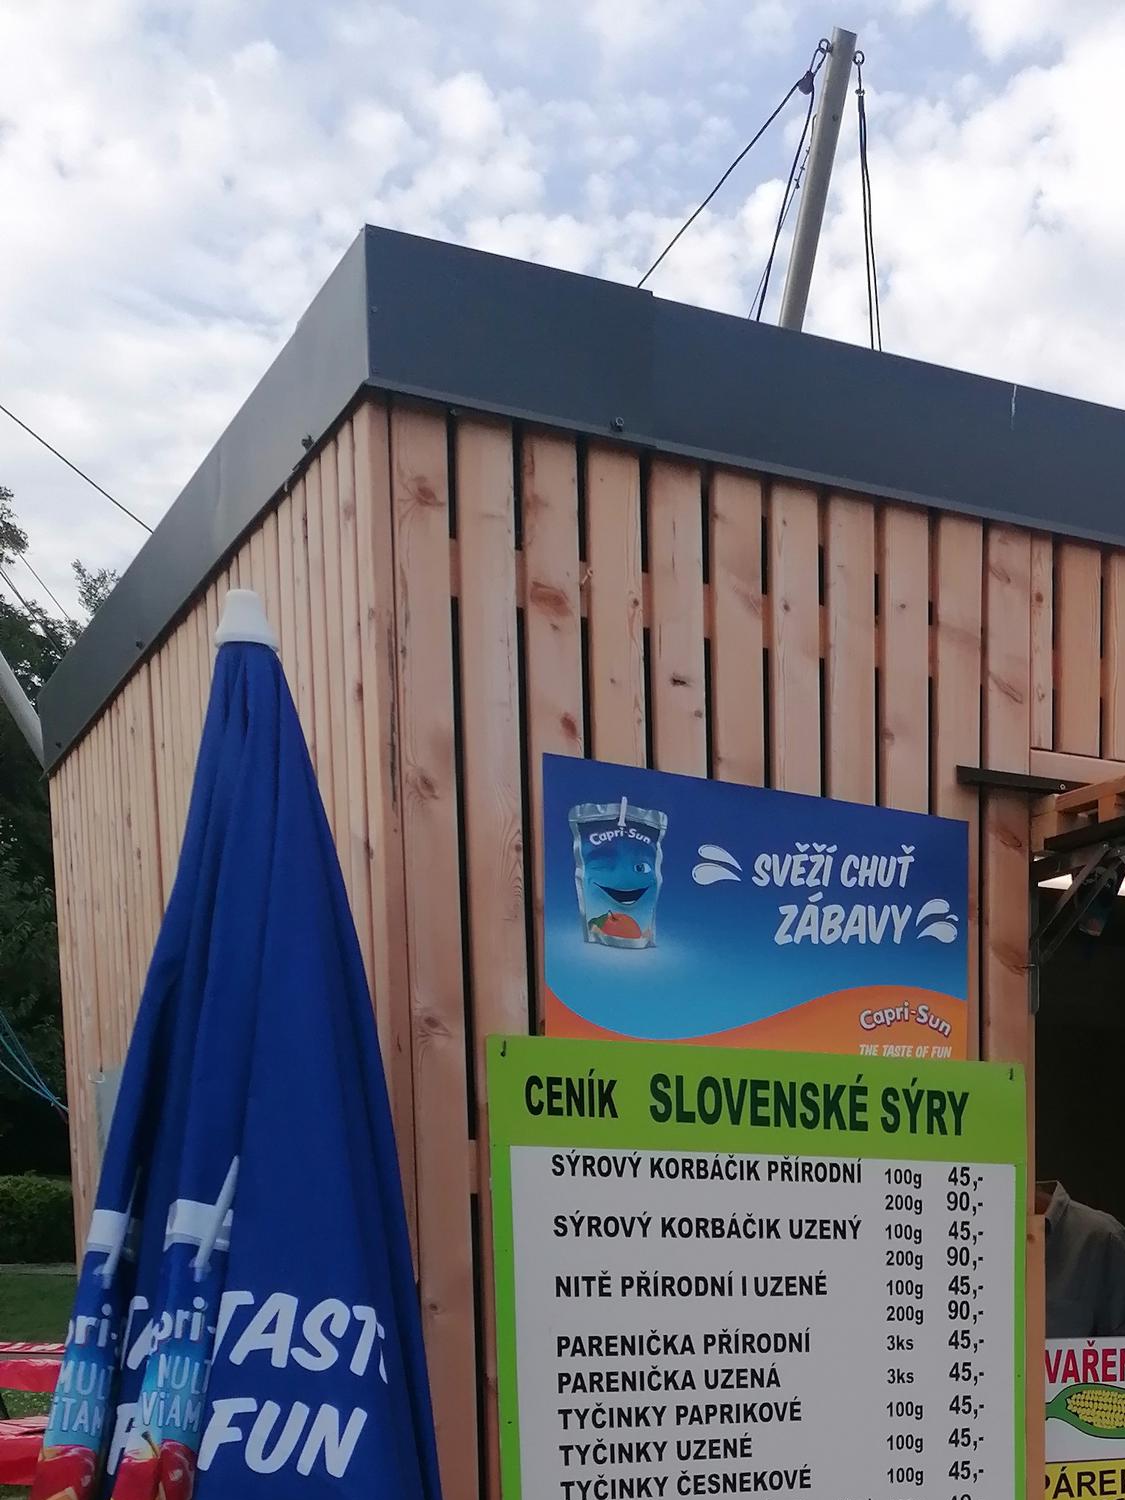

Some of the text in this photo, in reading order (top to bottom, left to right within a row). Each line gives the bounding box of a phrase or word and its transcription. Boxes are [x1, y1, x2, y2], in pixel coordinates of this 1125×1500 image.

[589, 826, 652, 846] Capri-Sun
[752, 842, 916, 888] SVĚŽÍ CHUŤ
[774, 891, 913, 945] ZÁBAVY
[859, 1001, 952, 1038] Capri-Sun
[859, 1044, 952, 1058] THE TASTE OF FUN
[525, 1068, 970, 1136] CENÍK SLOVENSKÉ SÝRY
[551, 1149, 984, 1189] SÝROVÝ KORBÁČIK PŘÍRODNÍ 100g 45,-
[885, 1191, 983, 1215] 200g 90,-
[553, 1210, 863, 1241] SÝROVÝ KORBÁČIK UZENÝ
[555, 1270, 827, 1298] NITĚ PŘÍRODNÍ I UZENÉ
[556, 1327, 914, 1357] PARENIČKA PŘÍRODNÍ 3ks
[557, 1363, 915, 1394] PARENIČKA UZENÁ 3ks
[558, 1396, 802, 1430] TYČINKY PAPRIKOVÉ
[196, 1397, 368, 1478] FUN
[559, 1432, 753, 1466] TYČINKY UZENÉ
[676, 1464, 813, 1497] ČESNEKOVÉ
